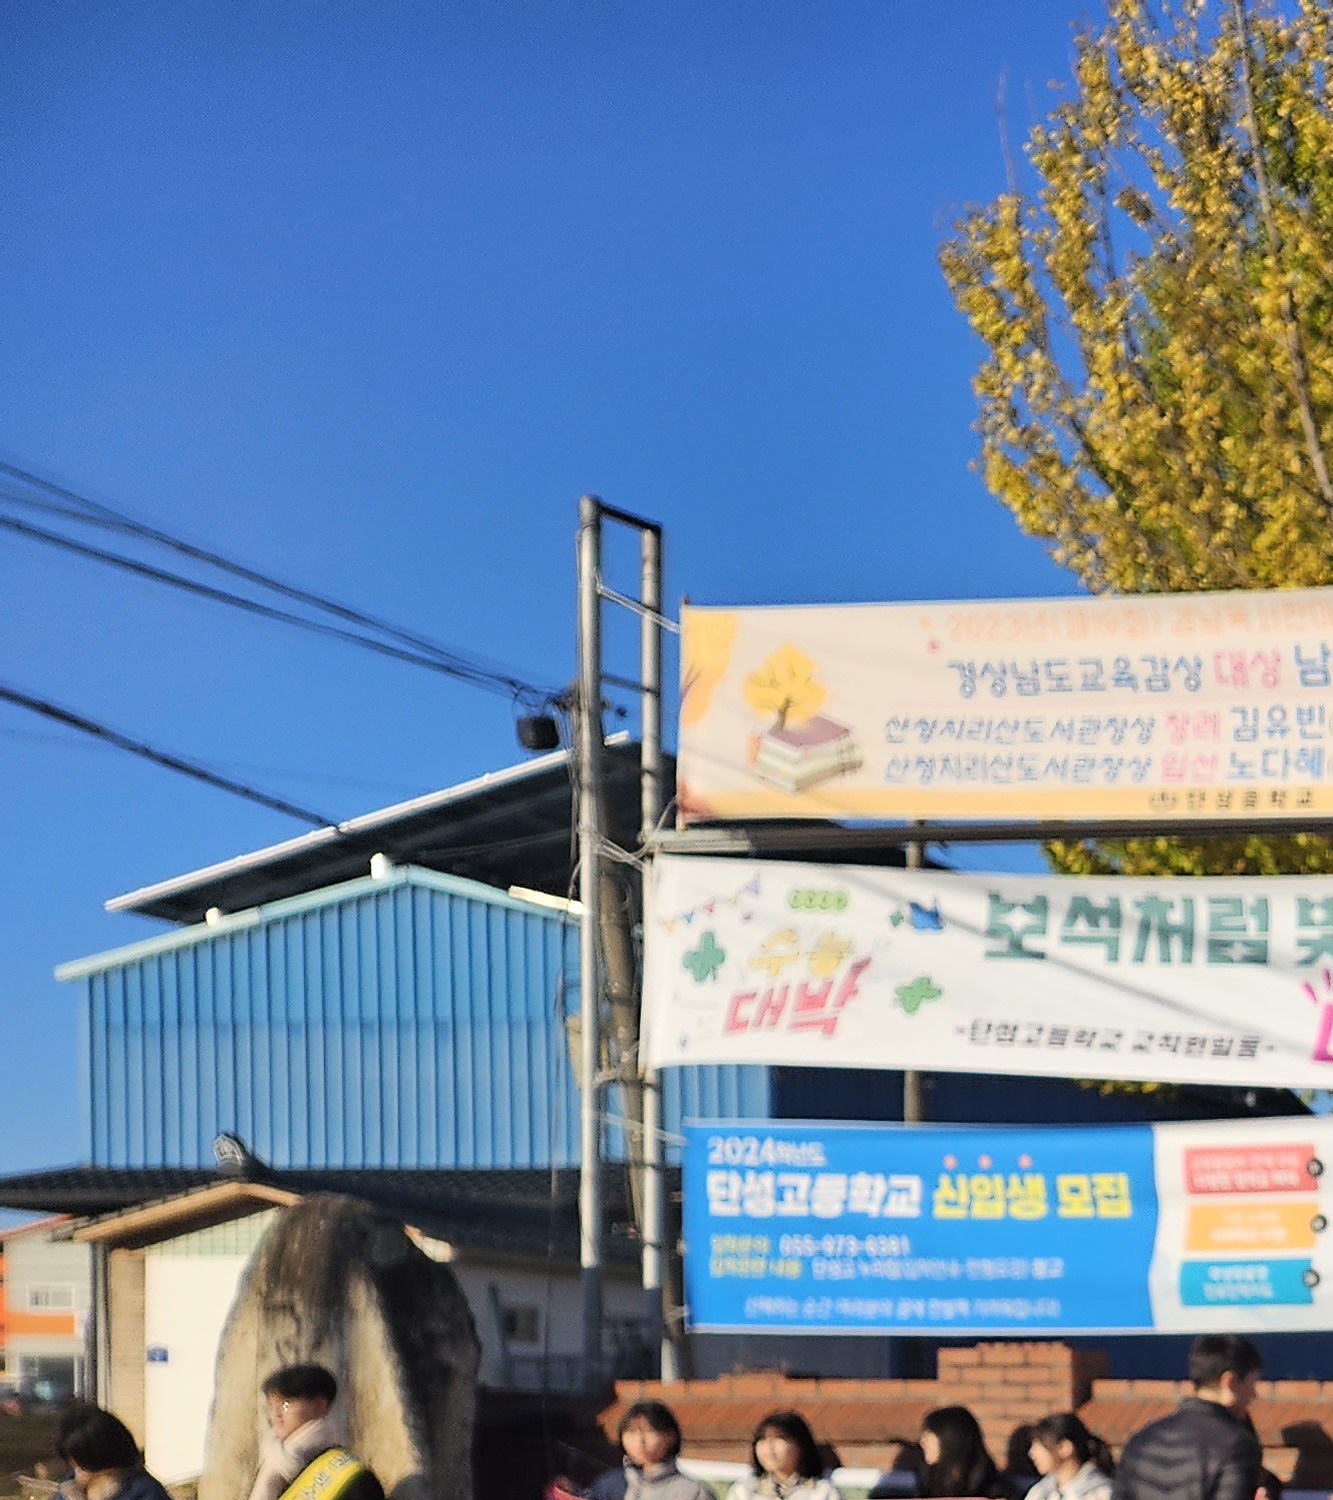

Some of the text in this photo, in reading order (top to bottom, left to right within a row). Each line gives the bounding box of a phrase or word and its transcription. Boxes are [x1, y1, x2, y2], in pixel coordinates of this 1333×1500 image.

[946, 652, 1203, 699] 경상남도교육감상
[1212, 648, 1282, 690] 대상
[983, 889, 1270, 965] 보석처럼
[724, 955, 873, 1038] 대박
[706, 1171, 1133, 1220] 단성고등학교 신입생 모집
